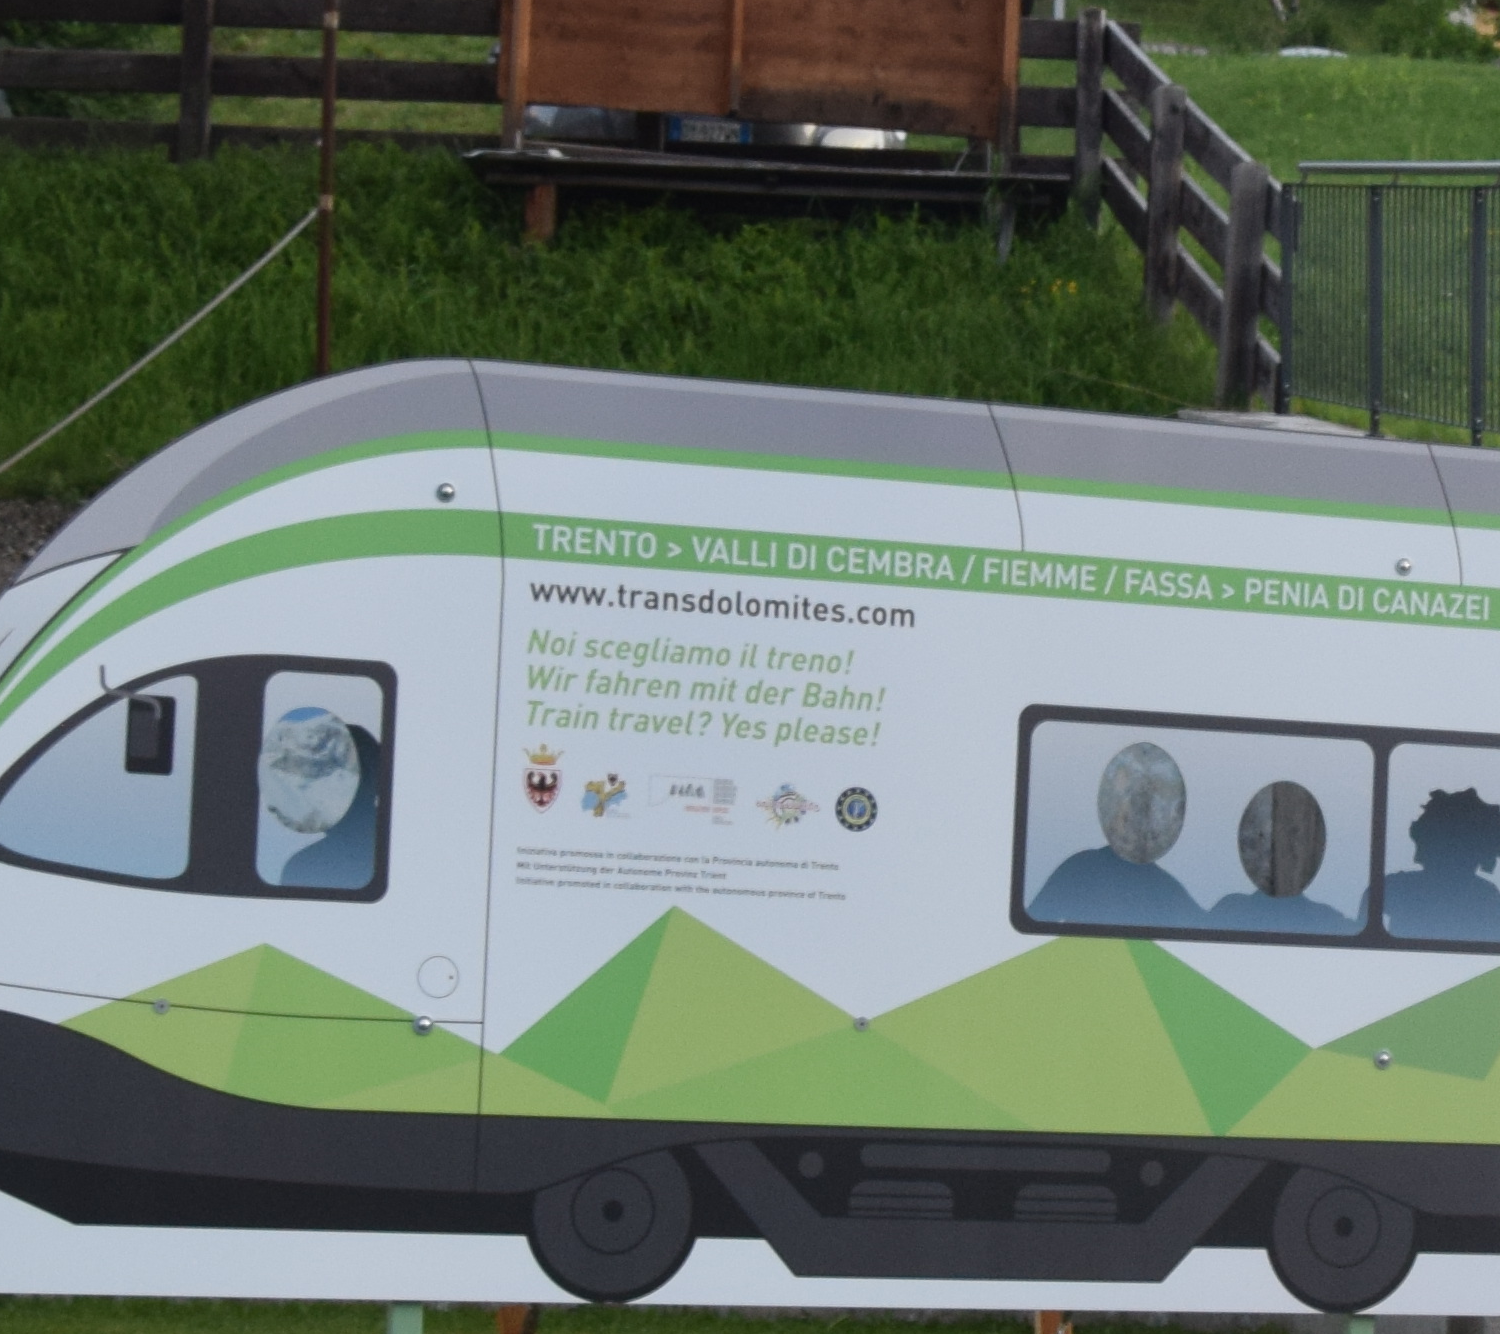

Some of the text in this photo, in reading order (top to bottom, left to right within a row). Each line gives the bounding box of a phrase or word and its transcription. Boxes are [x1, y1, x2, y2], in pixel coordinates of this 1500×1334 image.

[532, 522, 657, 558] TRENTO
[691, 535, 778, 568] VALLI
[788, 543, 818, 570] DI
[826, 546, 955, 582] CEMBRA
[983, 557, 1097, 592] FIEMME
[1124, 568, 1214, 602] FASSA
[1245, 578, 1330, 610] PENIA
[1337, 585, 1364, 612] DI
[1373, 587, 1492, 622] CANAZEI
[529, 581, 917, 628] www.transdolomites.com
[526, 628, 855, 676] Noi scegliamo il treno!
[526, 664, 887, 712] Wir fahren mit der Bahn!
[526, 700, 882, 749] Train travel? Yes please!
